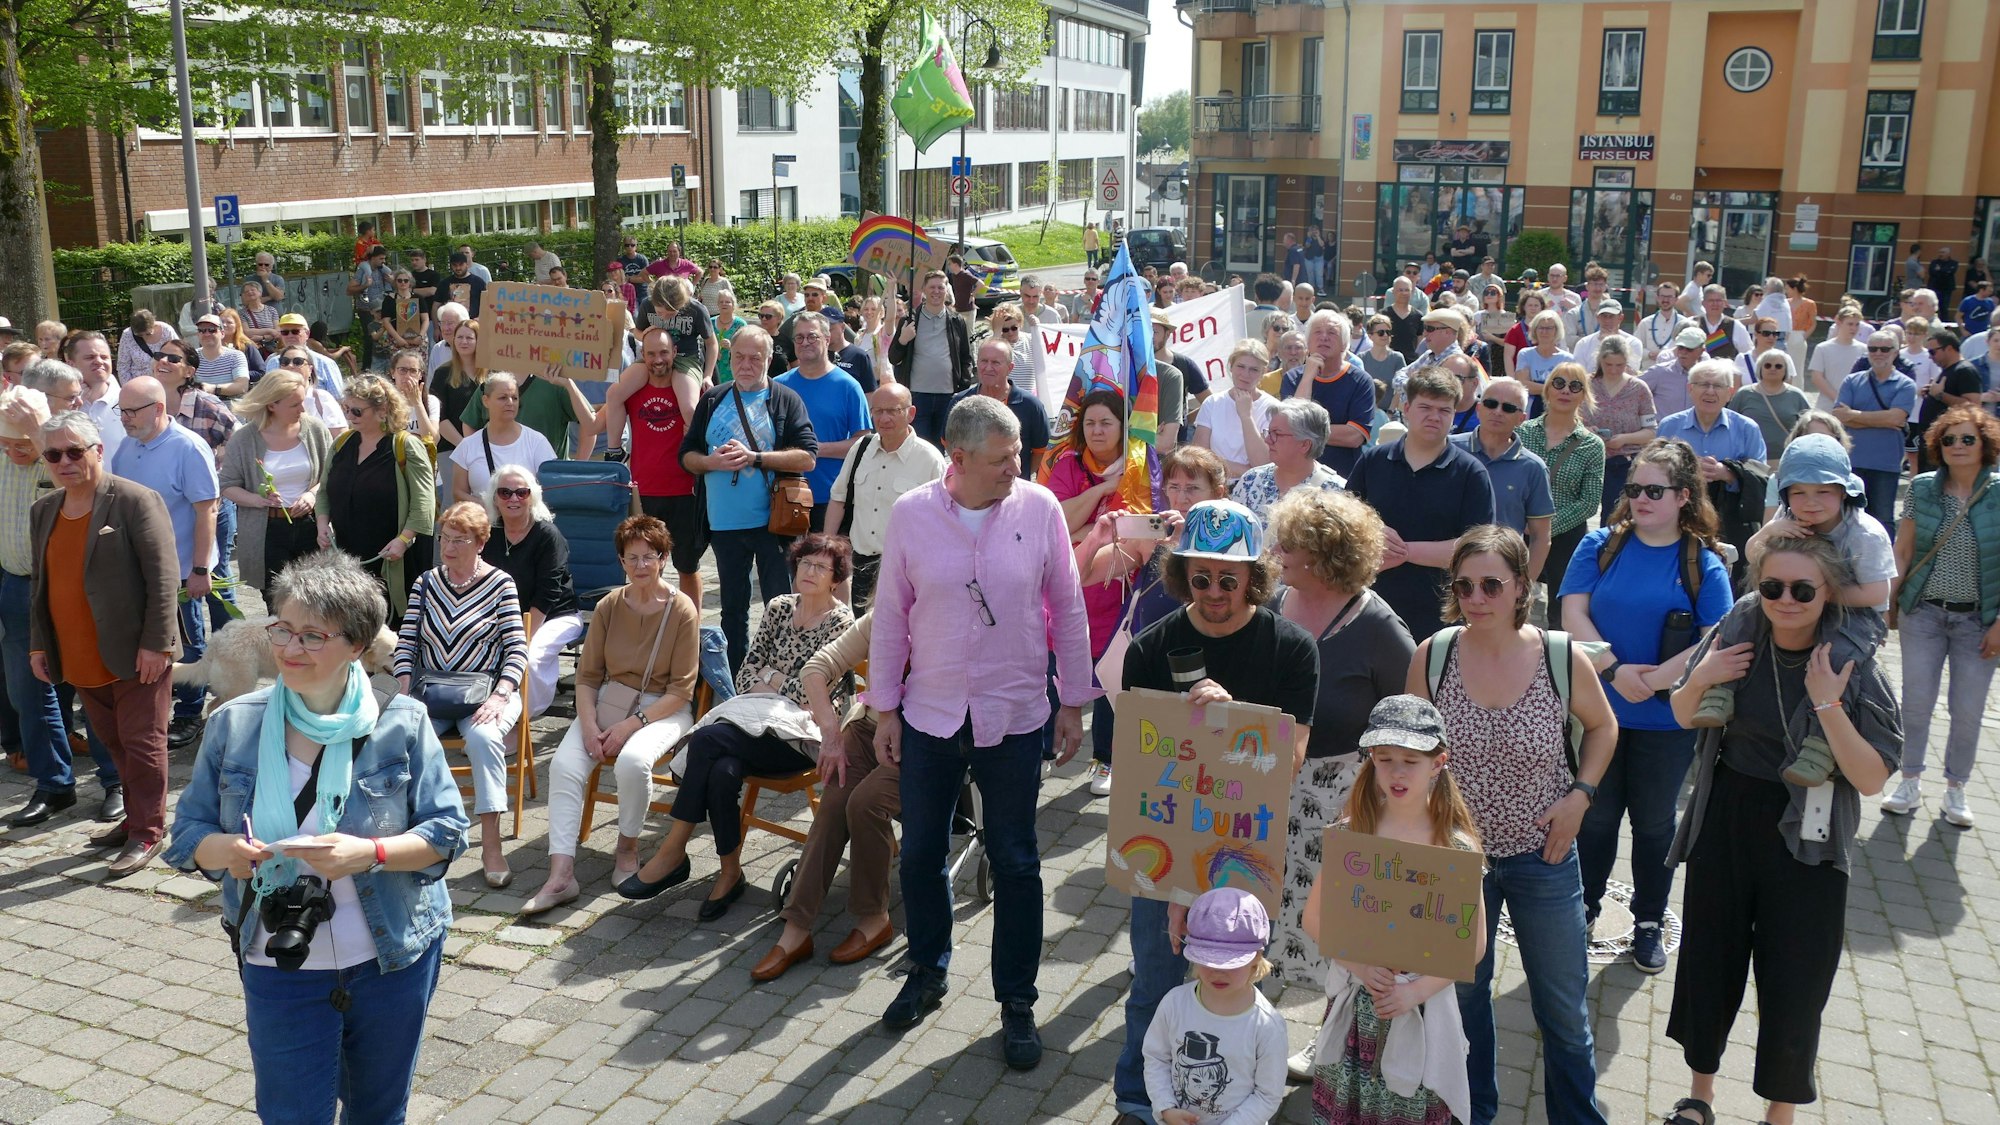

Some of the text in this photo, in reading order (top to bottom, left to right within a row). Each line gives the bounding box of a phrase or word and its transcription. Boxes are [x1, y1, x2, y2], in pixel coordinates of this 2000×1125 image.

[1583, 135, 1654, 148] ISTANBUL
[1580, 150, 1651, 160] FRISEUR
[674, 168, 682, 185] P
[1106, 189, 1115, 197] 20
[1356, 184, 1363, 192] 6
[1669, 193, 1682, 201] 4a
[218, 199, 233, 224] P
[913, 249, 931, 263] IND
[494, 322, 600, 342] Meine Freunde sind
[496, 344, 522, 359] alle
[646, 419, 676, 432] TRADEMARK
[1139, 718, 1197, 761] Das
[1155, 761, 1243, 800] Leben
[1139, 792, 1274, 842] ist bunt
[1343, 851, 1441, 886] Glitzer
[1351, 884, 1478, 940] für alle!
